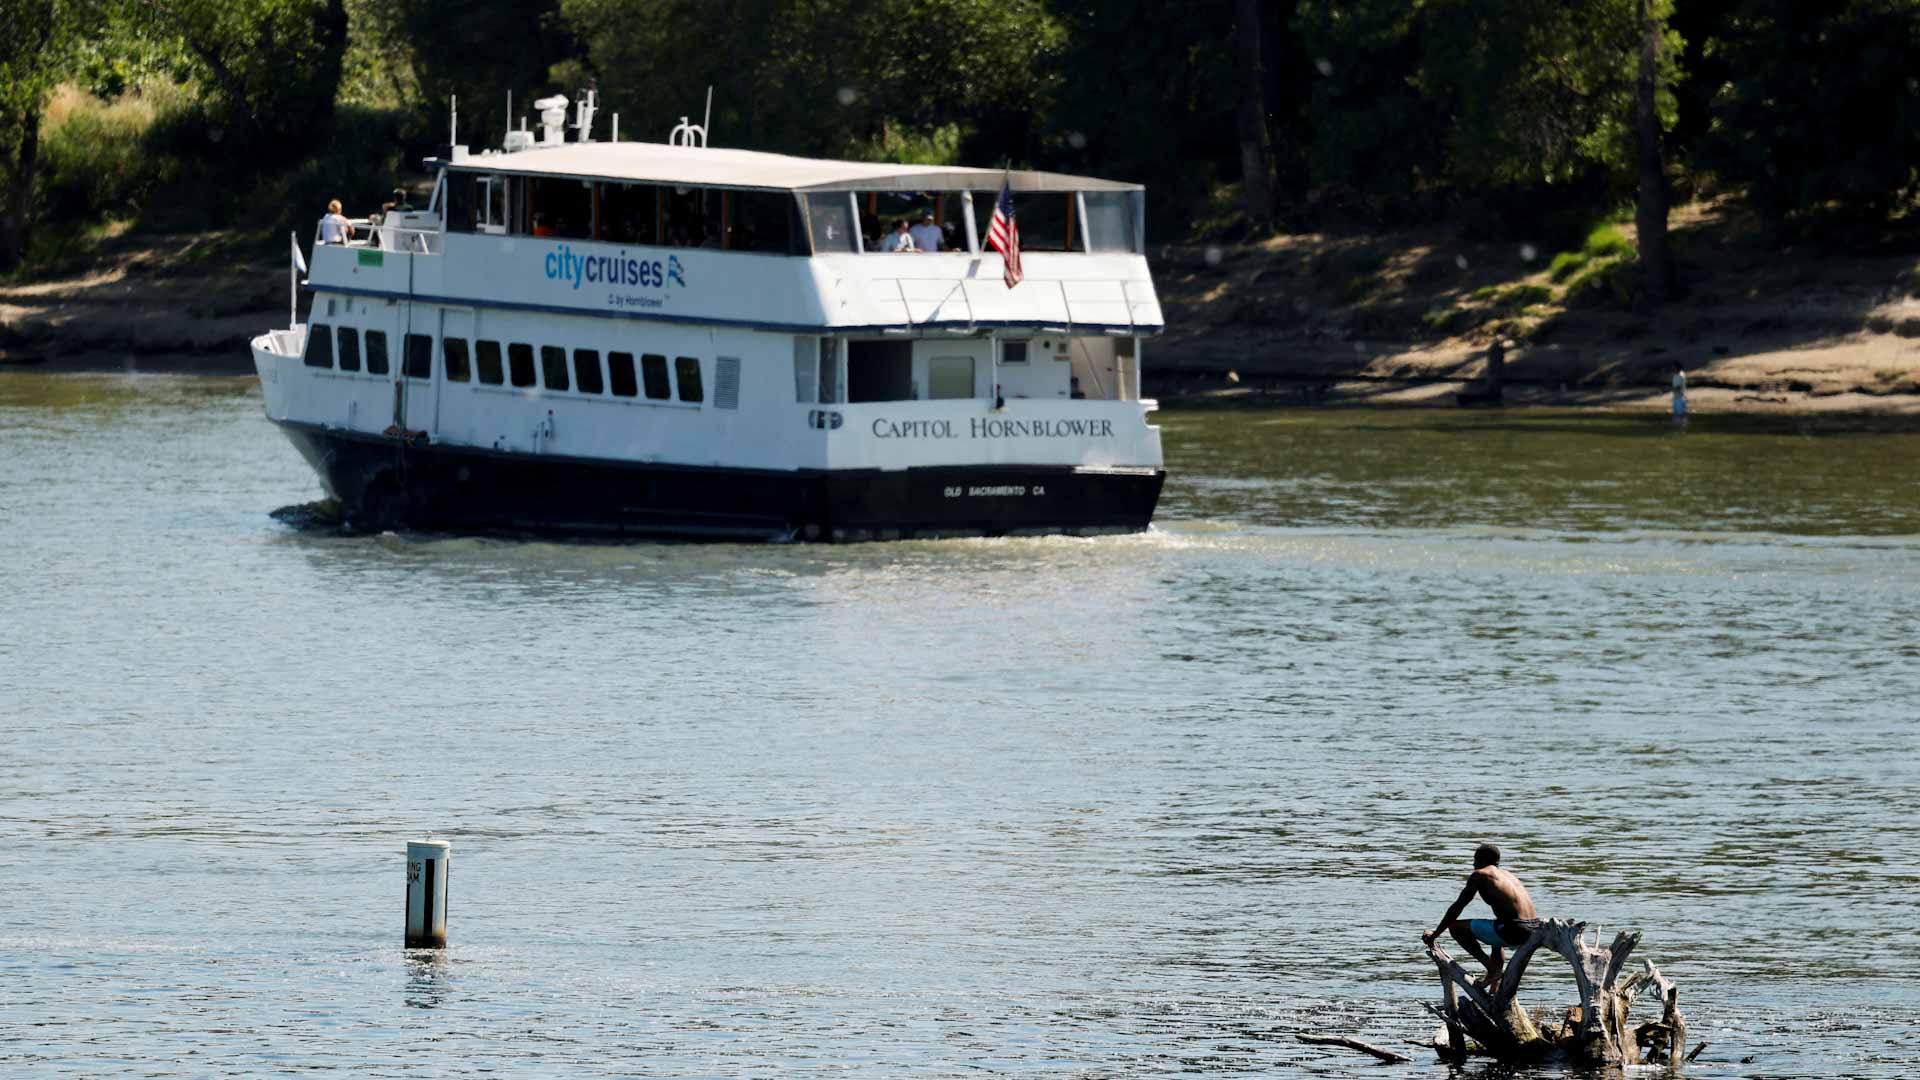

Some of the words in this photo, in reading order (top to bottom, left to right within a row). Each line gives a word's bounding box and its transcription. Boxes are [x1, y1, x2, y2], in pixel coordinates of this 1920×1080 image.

[944, 486, 961, 497] OLD
[967, 485, 1025, 496] SACRAMENTO
[1032, 485, 1045, 496] CA
